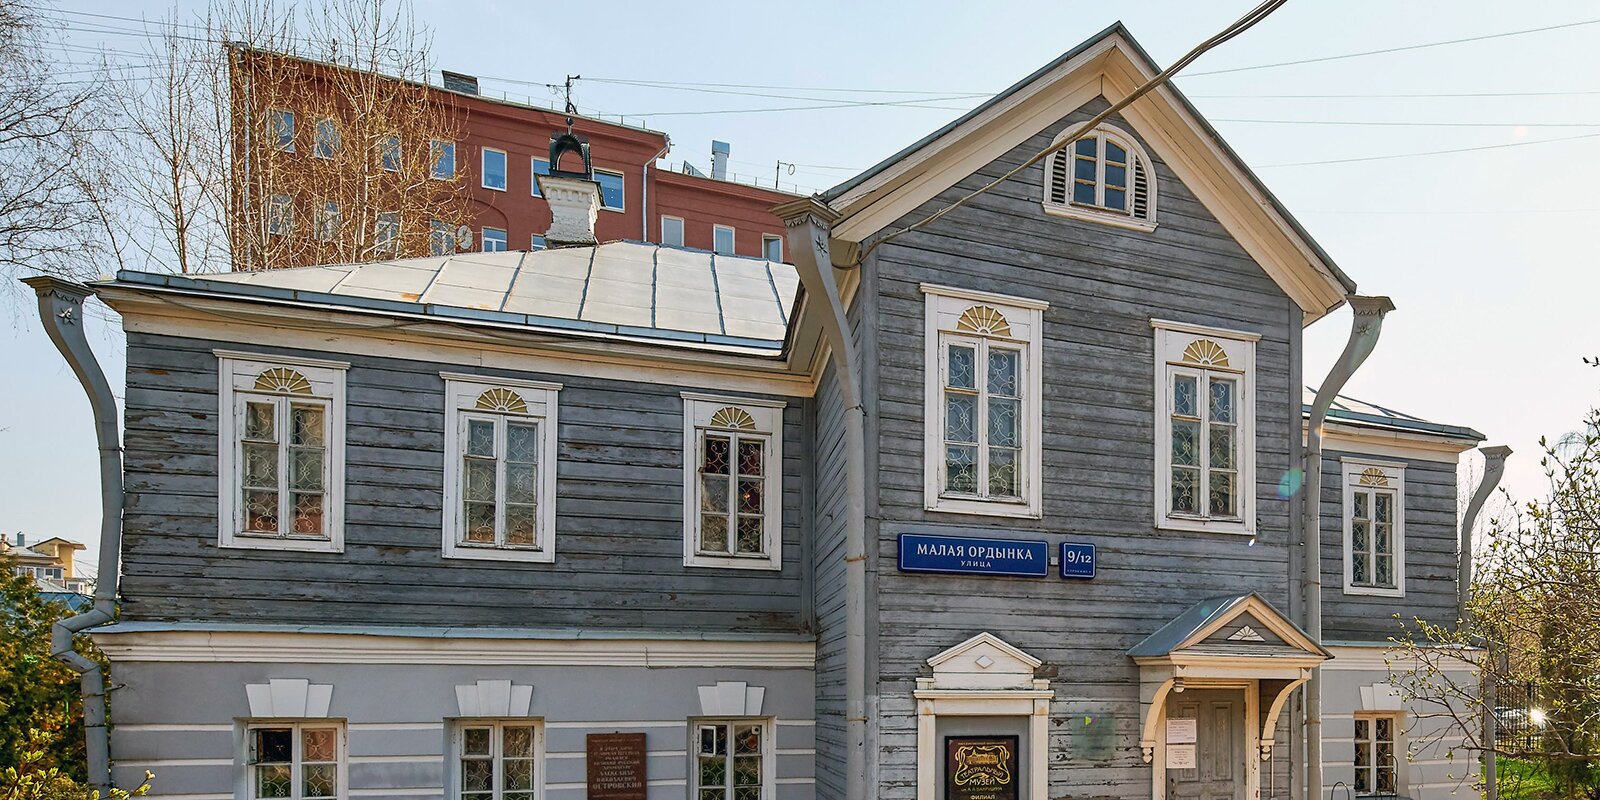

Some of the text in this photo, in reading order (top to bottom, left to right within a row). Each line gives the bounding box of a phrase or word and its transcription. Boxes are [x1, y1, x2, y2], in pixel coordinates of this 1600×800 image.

[917, 543, 1033, 560] МАЛАЯ ОРДЫНКА
[1067, 550, 1092, 564] 9/12
[960, 560, 992, 568] УЛИЦА
[960, 766, 1004, 779] ТЕАТРАЛЬНЫЙ
[592, 782, 642, 790] ОСТРОВСКИЙ
[969, 776, 996, 786] МУЗЕЙ
